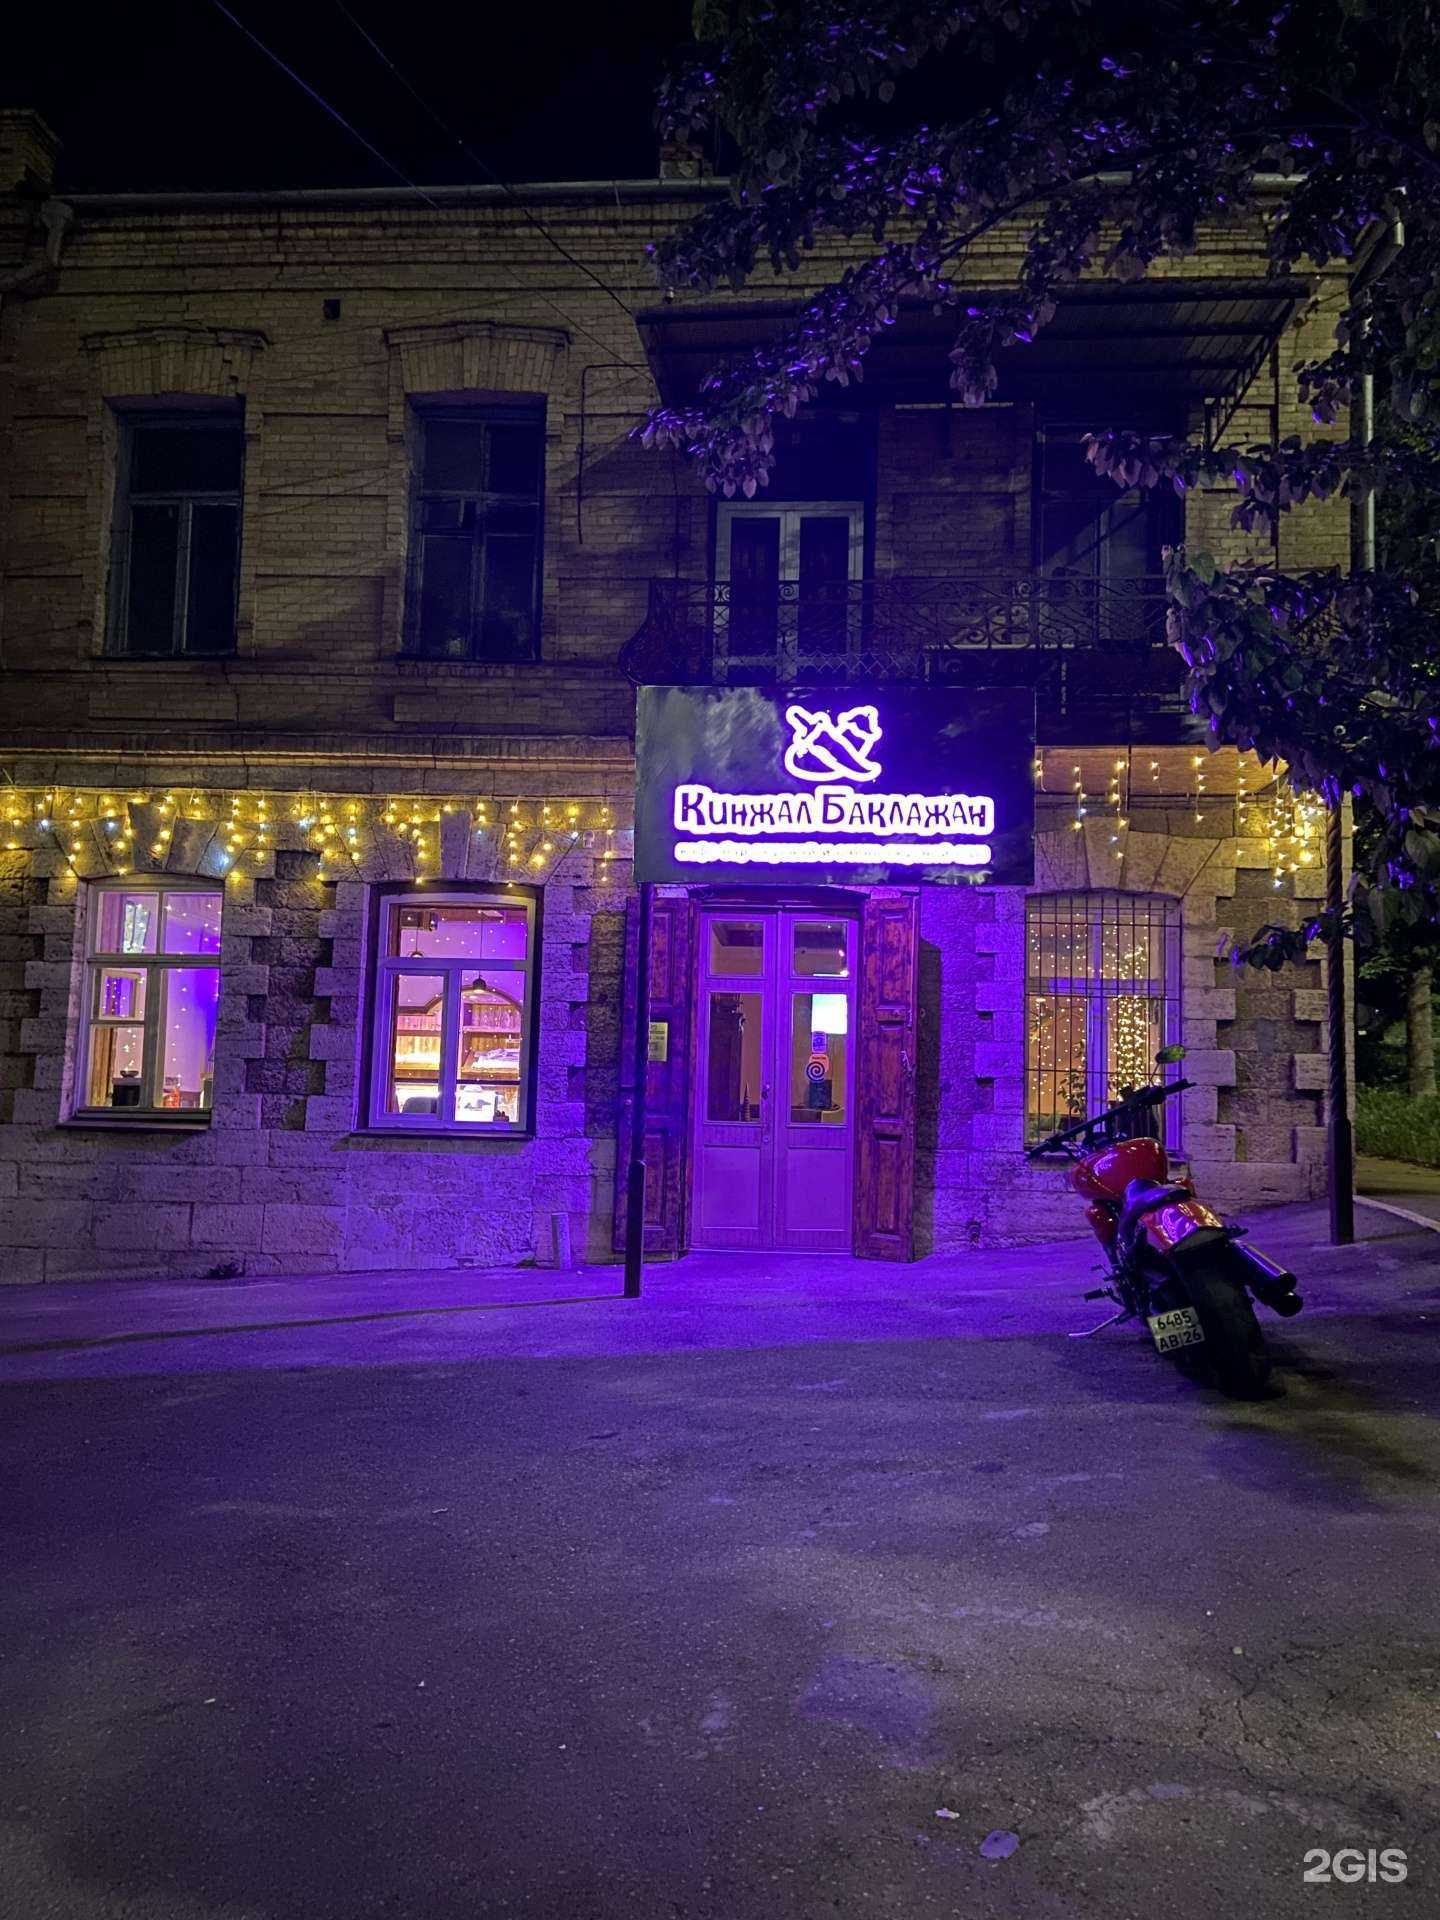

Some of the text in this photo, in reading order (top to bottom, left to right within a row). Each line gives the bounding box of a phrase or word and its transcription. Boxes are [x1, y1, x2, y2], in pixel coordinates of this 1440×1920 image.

[678, 788, 991, 831] Кинжал Баклажан
[1157, 1310, 1192, 1330] 6485
